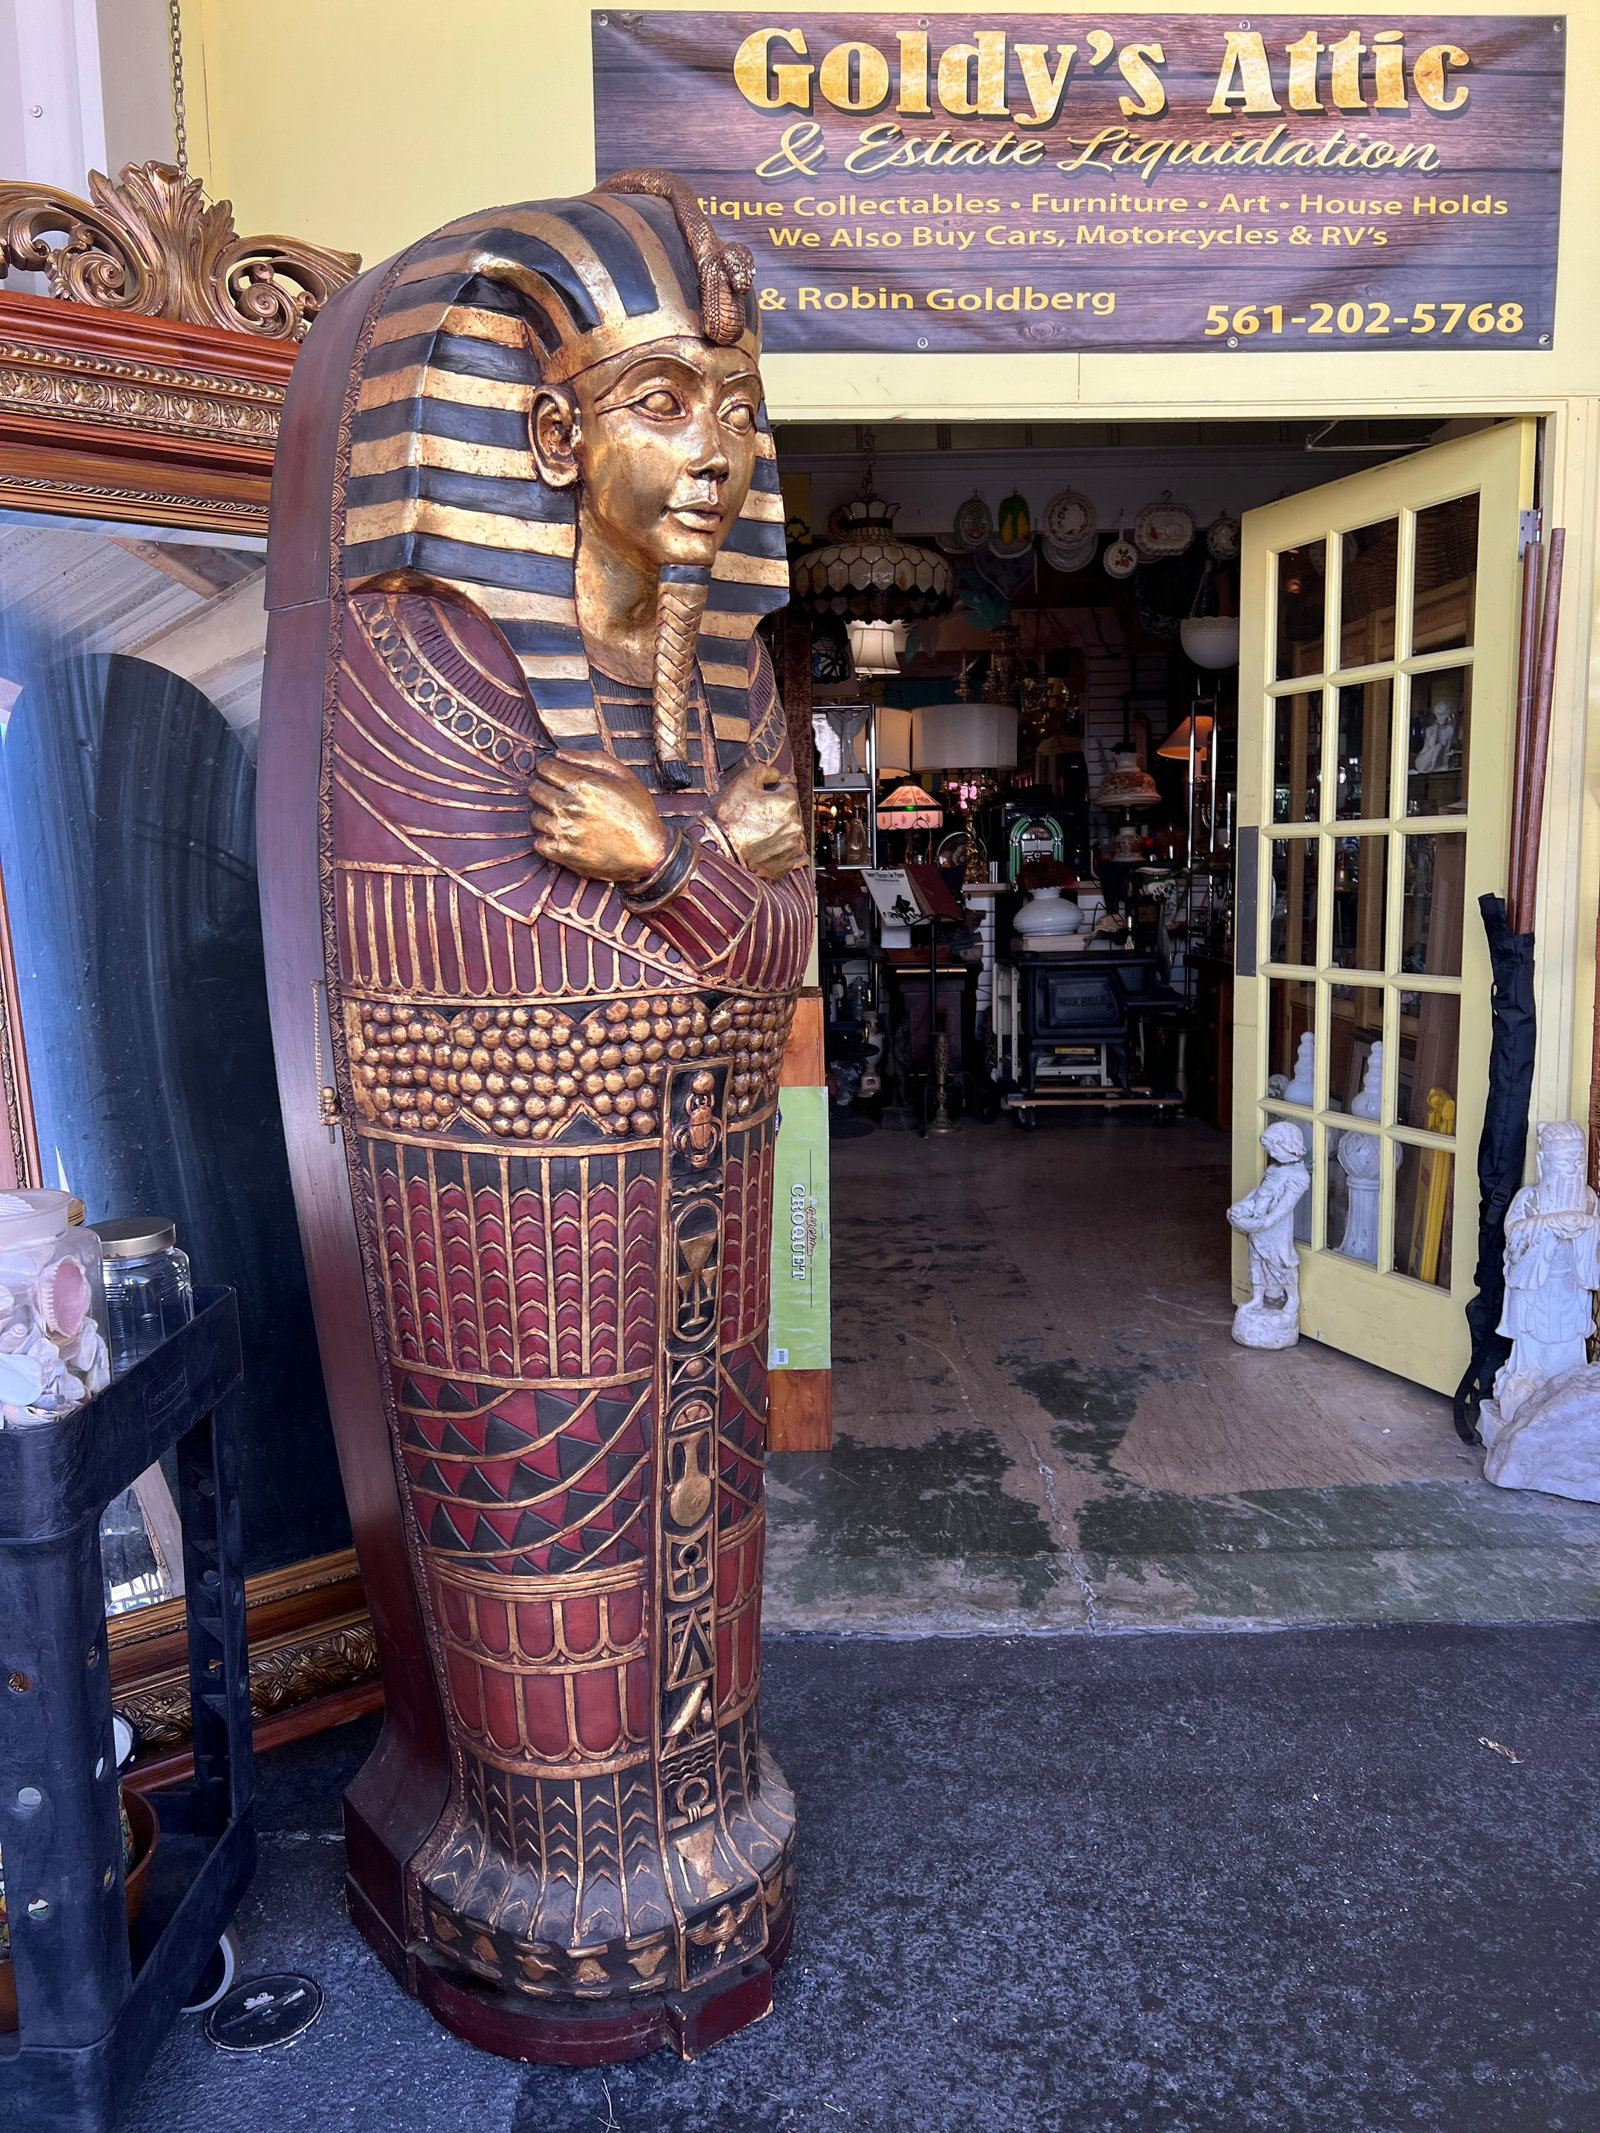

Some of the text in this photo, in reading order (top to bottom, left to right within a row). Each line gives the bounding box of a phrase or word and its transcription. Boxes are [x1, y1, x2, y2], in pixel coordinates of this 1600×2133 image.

[733, 28, 1470, 125] Goldy's Attic
[755, 121, 1441, 179] & Estate Liquidation
[697, 193, 1508, 220] tique Collectables Furniture Art House Holds
[768, 225, 1388, 251] We Also Buy Cars, Motorcycles & RV's
[758, 286, 1116, 315] & Robin Goldberg
[1204, 302, 1523, 336] 561-202-5768
[791, 1184, 806, 1280] CROQUET
